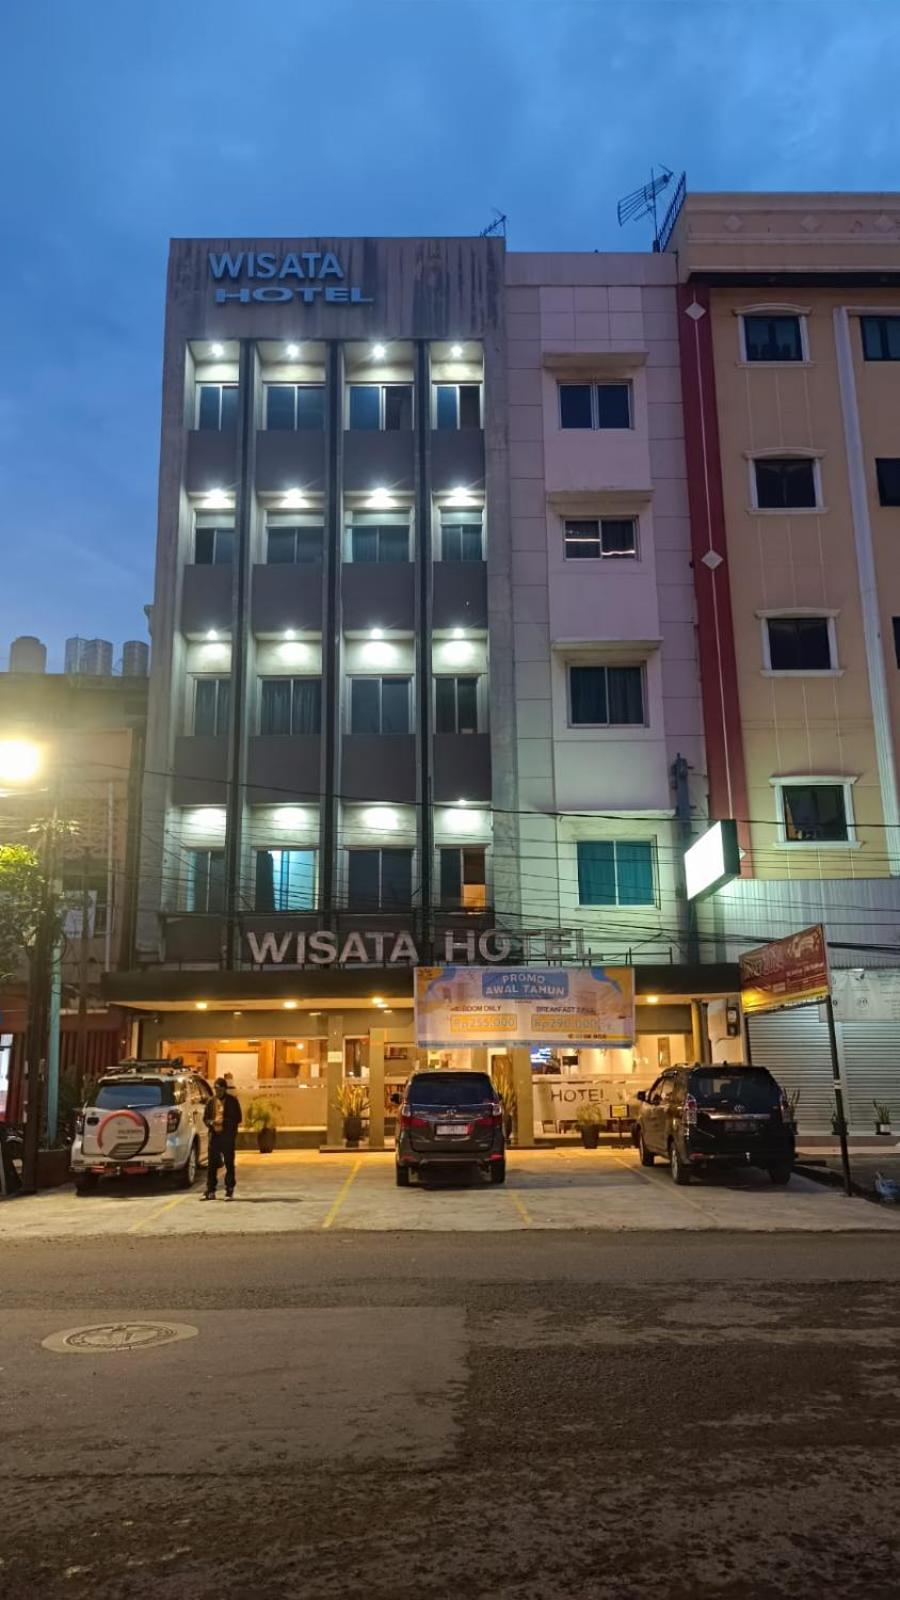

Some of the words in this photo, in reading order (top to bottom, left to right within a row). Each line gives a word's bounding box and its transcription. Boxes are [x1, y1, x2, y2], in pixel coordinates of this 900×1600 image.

[208, 252, 344, 279] WISATA
[215, 287, 374, 303] HOTEL
[247, 930, 419, 964] WISATA
[445, 928, 602, 962] HOTEL
[502, 973, 545, 984] PROMO
[485, 985, 519, 995] AWAL
[523, 985, 565, 995] TAHUN
[484, 1004, 501, 1012] ONLY
[550, 1088, 610, 1102] HOTEL
